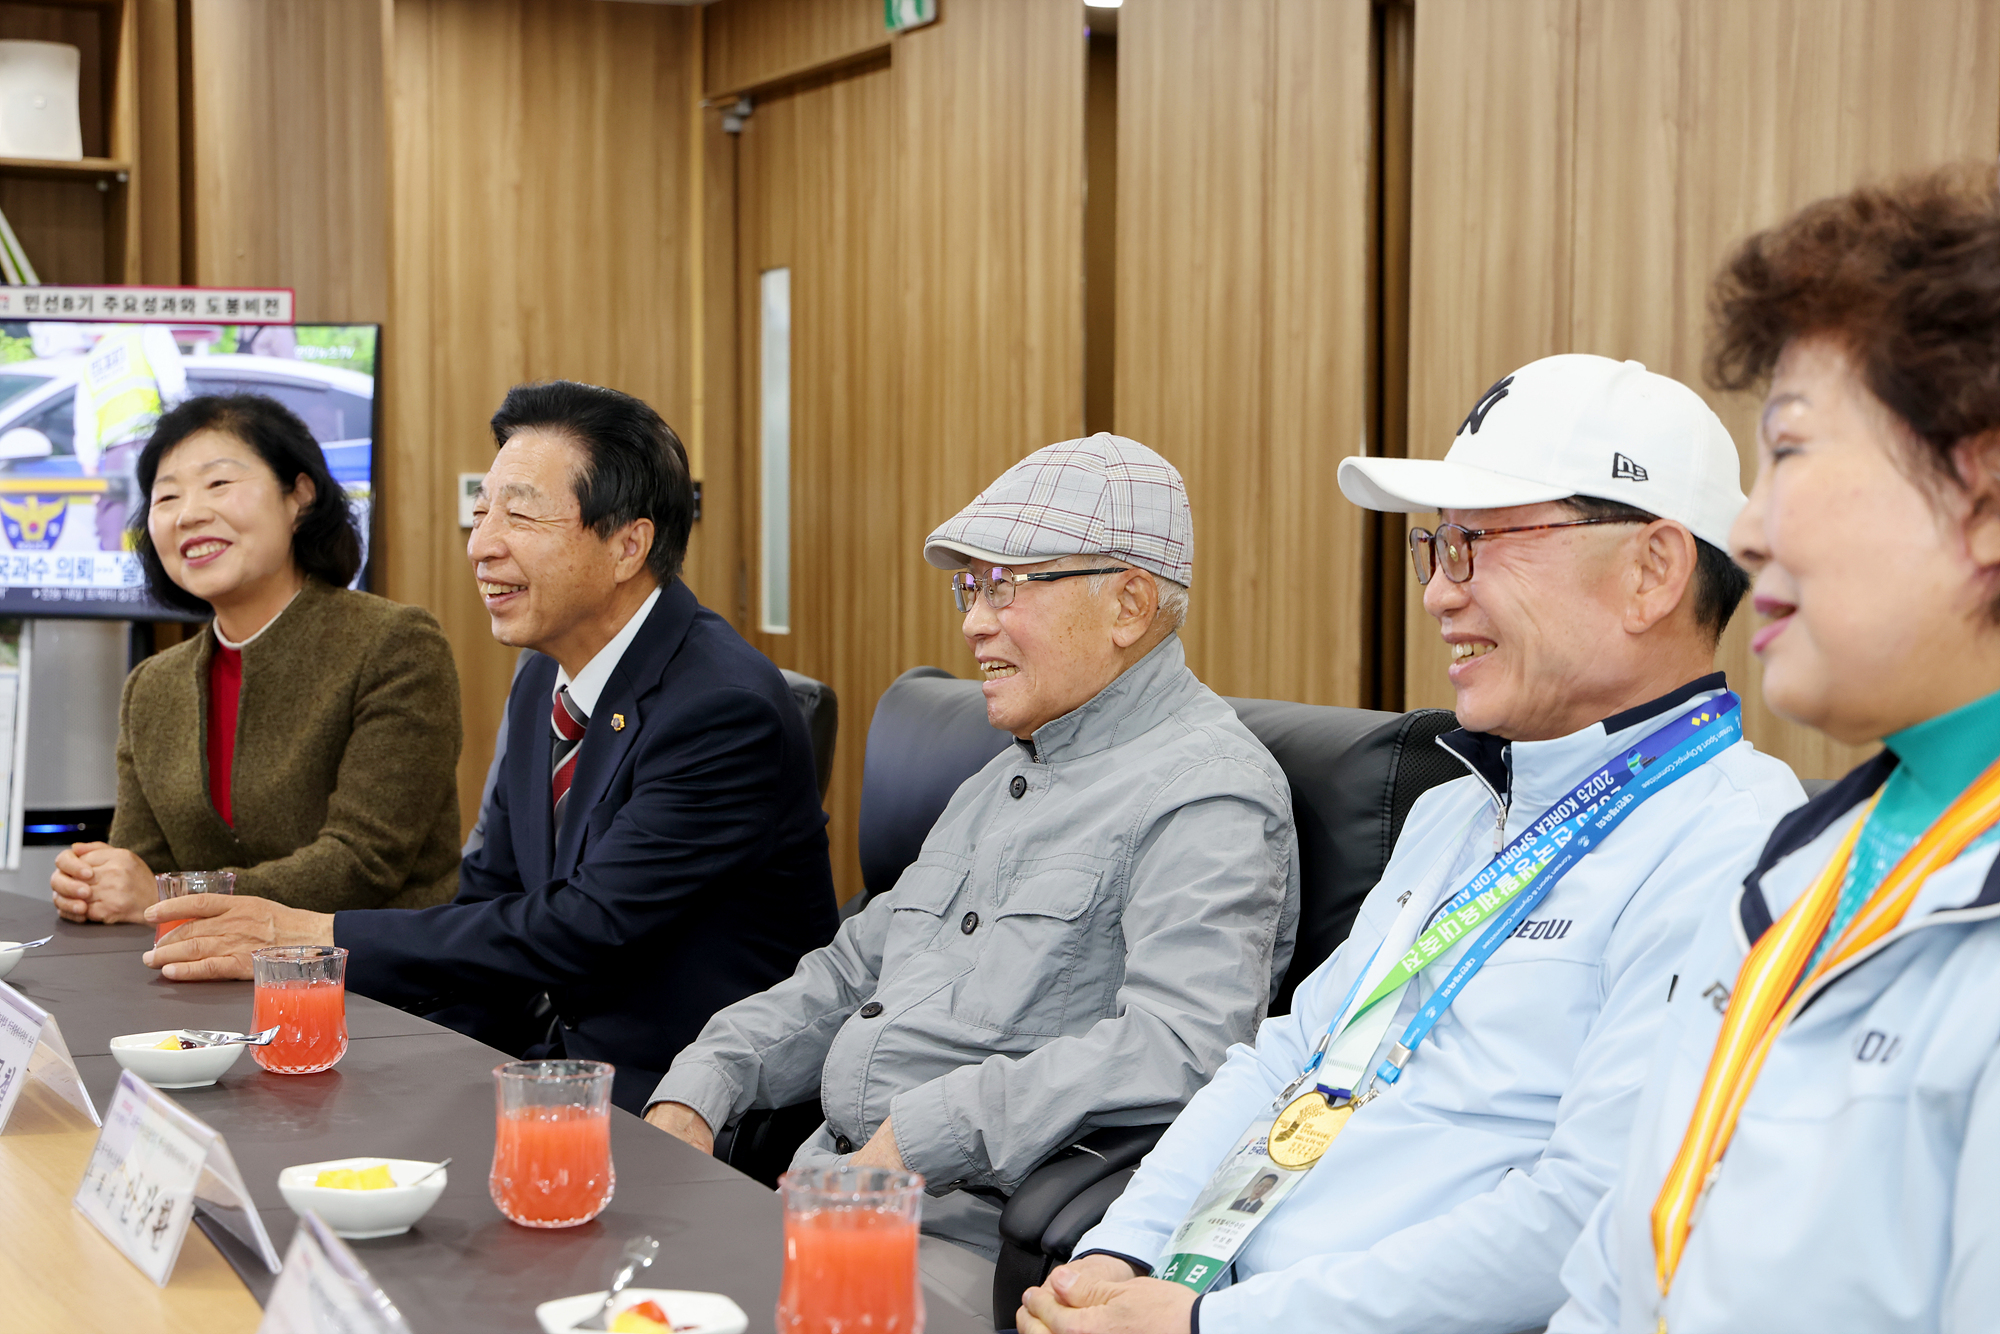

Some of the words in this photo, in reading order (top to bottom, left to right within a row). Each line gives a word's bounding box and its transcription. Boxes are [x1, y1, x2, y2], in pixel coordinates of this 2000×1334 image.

[1701, 735, 1719, 750] Sport
[1676, 749, 1699, 766] Olympic
[1576, 769, 1614, 804] 2025
[1641, 763, 1676, 789] Committee
[1534, 797, 1579, 836] KOREA
[1595, 793, 1634, 829] 대한체육회
[1496, 832, 1538, 872] SPORT
[1551, 854, 1573, 875] Korean
[1471, 867, 1498, 892] FOR
[1537, 874, 1553, 891] Sport
[1449, 888, 1471, 909] ALL
[1511, 895, 1533, 919] Olympic
[1482, 917, 1512, 950] Committee
[1441, 957, 1476, 998] 대한체육회
